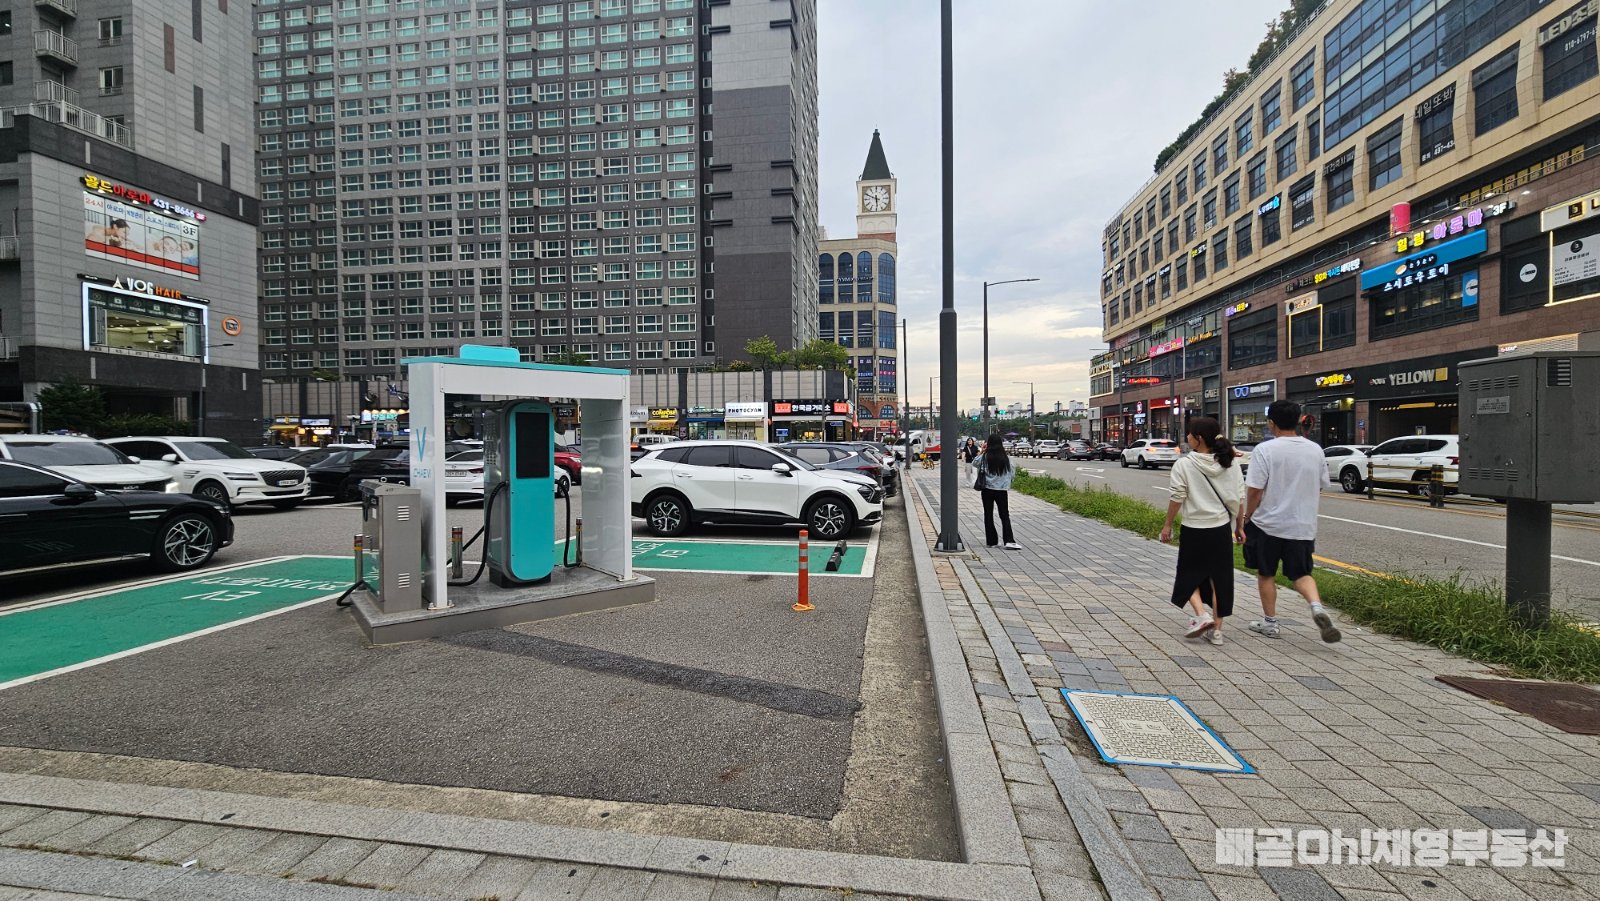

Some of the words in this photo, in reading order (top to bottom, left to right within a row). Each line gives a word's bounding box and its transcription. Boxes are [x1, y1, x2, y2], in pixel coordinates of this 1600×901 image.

[153, 198, 195, 218] 431-8666
[182, 225, 196, 236] 3F
[1397, 231, 1425, 253] 힐링
[1433, 208, 1483, 240] 아로마
[1492, 202, 1508, 216] 3F
[1383, 263, 1449, 292] 스시토우토이
[155, 285, 182, 299] HAIR
[1389, 369, 1437, 386] YELLOW
